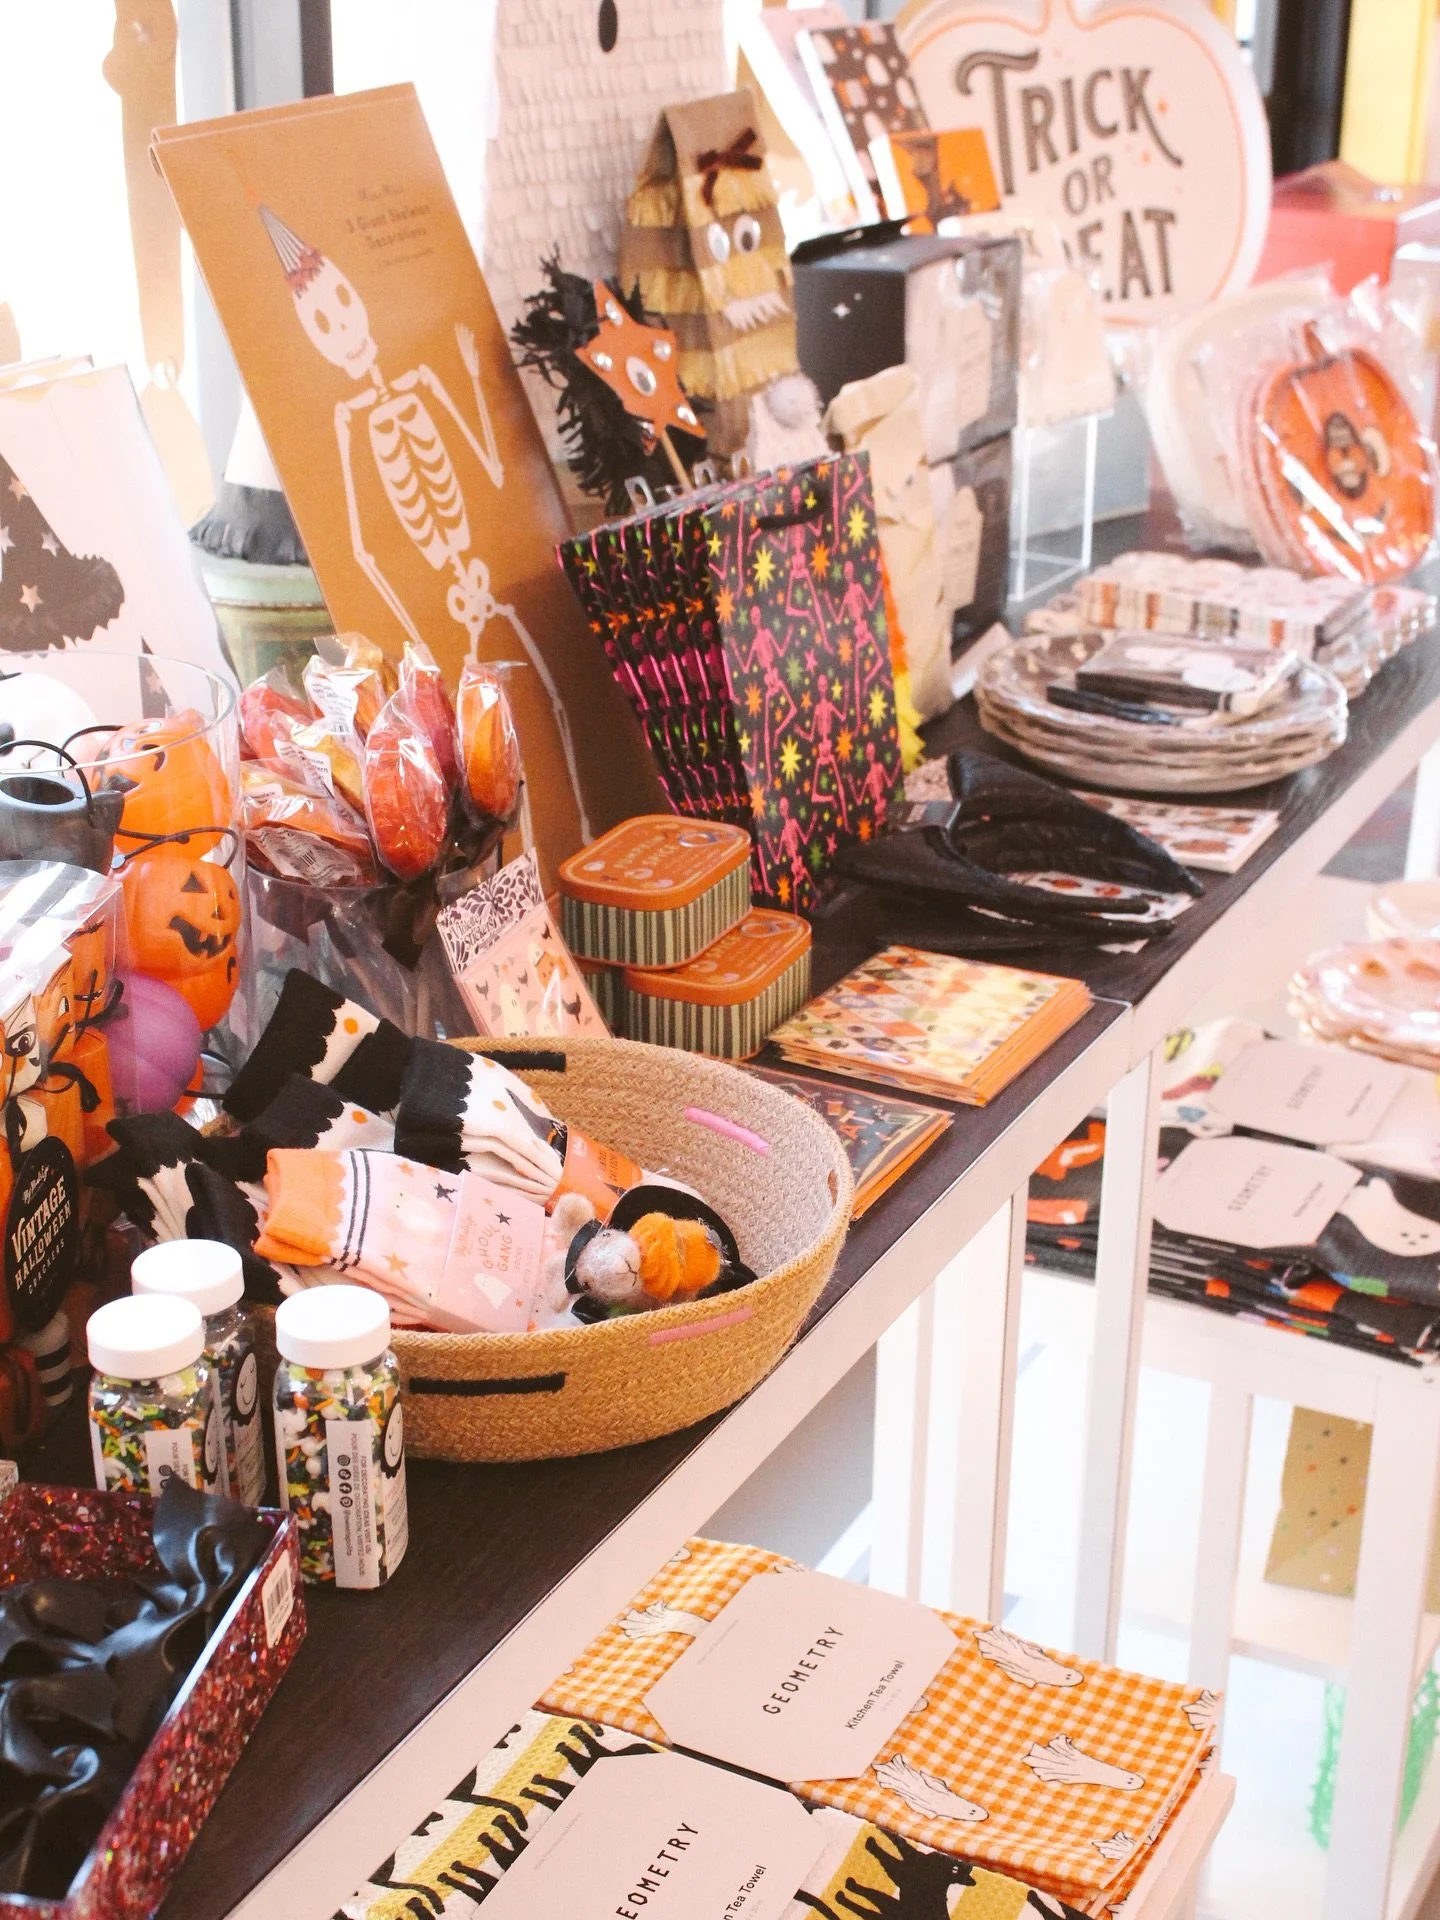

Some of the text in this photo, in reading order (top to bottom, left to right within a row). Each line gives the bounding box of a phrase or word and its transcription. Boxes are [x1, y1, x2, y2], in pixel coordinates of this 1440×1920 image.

[955, 48, 1183, 196] TRICK
[1062, 155, 1116, 216] OR
[11, 1175, 66, 1264] VINTAGE
[14, 1200, 72, 1291] HALLOWEEN
[478, 1224, 500, 1270] GHOUL
[497, 1234, 513, 1272] GANG
[762, 1626, 844, 1715] GEOMETRY
[844, 1699, 876, 1729] Kitchen
[868, 1684, 887, 1698] Tea
[879, 1660, 905, 1683] Towel
[615, 1822, 699, 1920] EOMETRY
[725, 1895, 746, 1915] Tea
[739, 1864, 767, 1895] Towel
